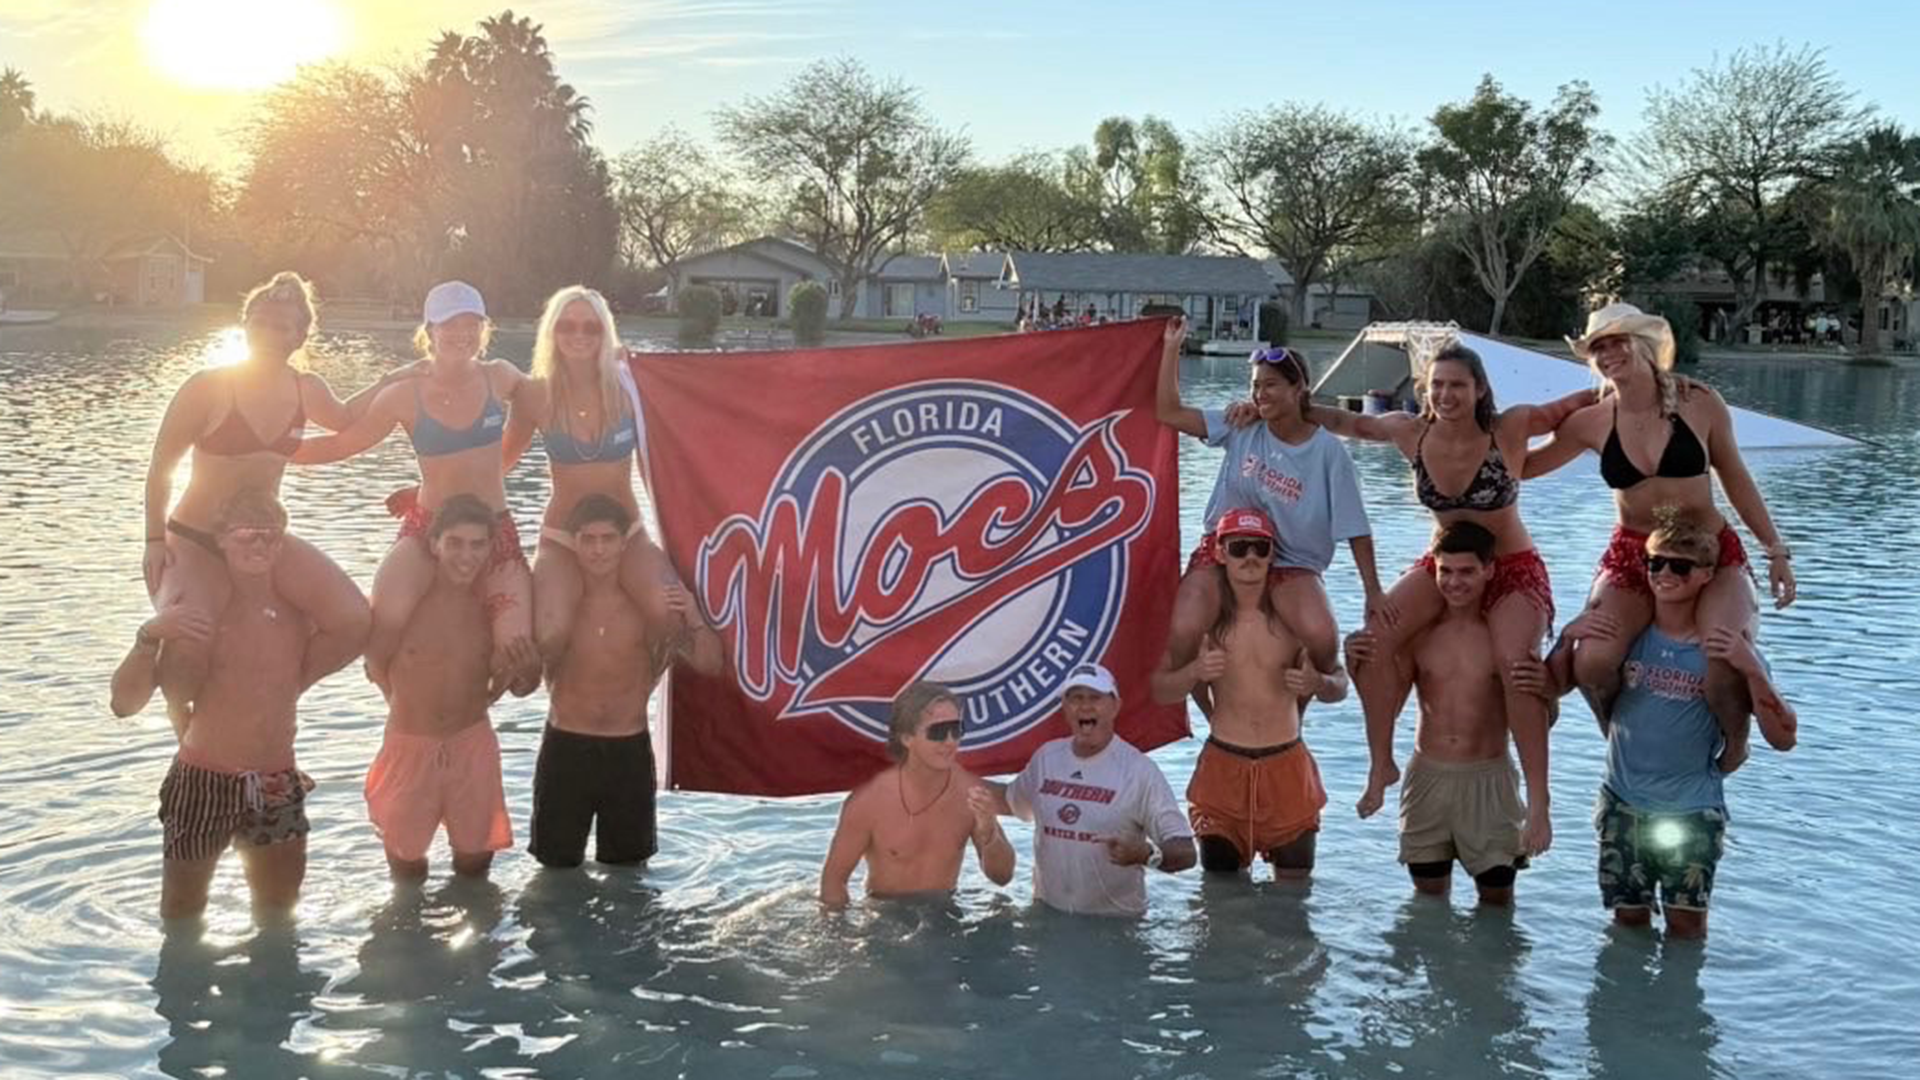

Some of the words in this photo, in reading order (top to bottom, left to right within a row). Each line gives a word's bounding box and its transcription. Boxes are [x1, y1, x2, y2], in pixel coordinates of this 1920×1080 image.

[851, 401, 1004, 455] FLORIDA
[697, 408, 1156, 719] Mocs
[966, 618, 1090, 725] UTHERN
[1039, 778, 1117, 805] SOUTHERN
[1044, 825, 1076, 840] WATER
